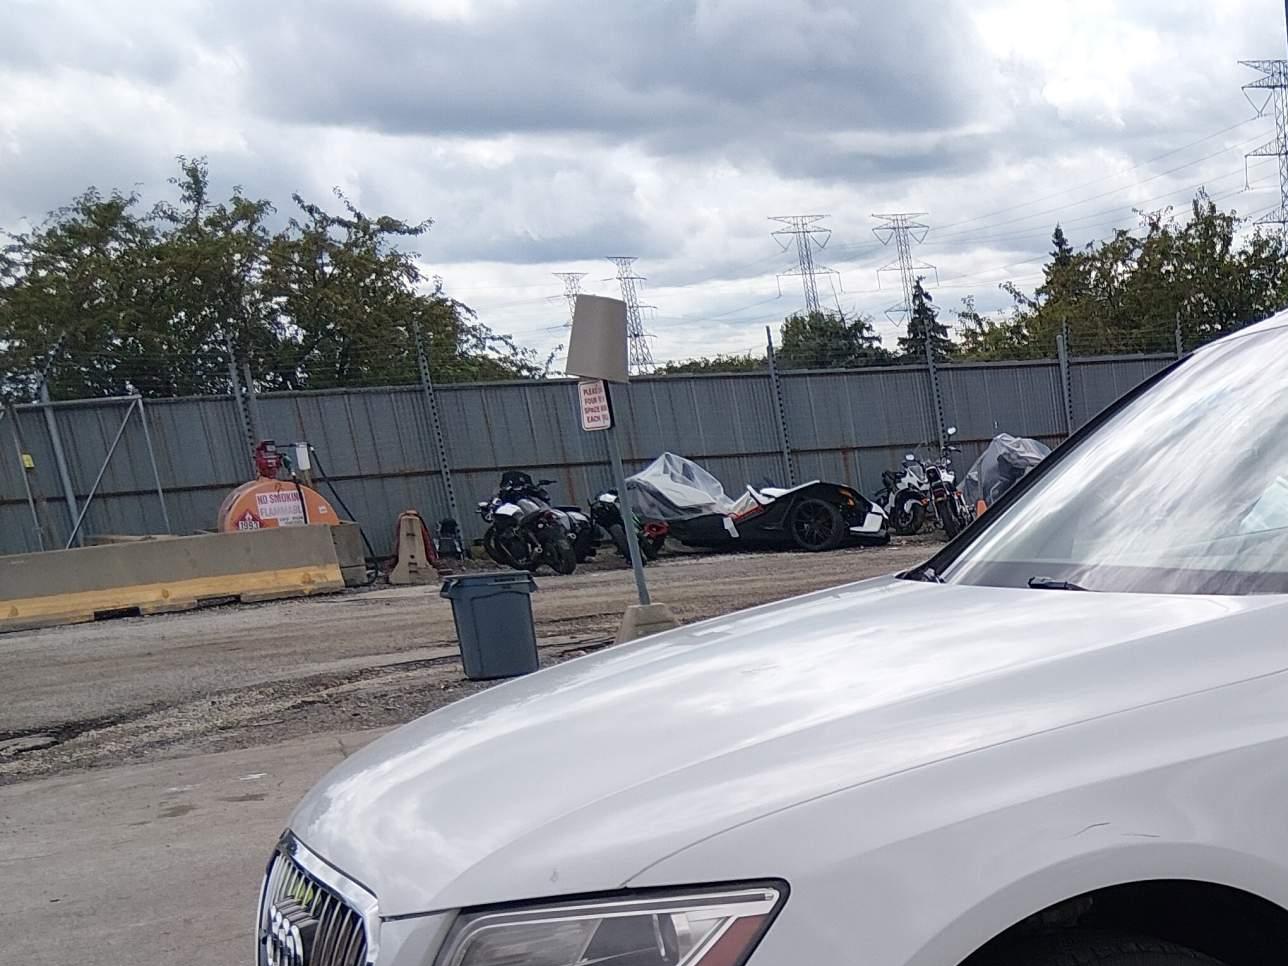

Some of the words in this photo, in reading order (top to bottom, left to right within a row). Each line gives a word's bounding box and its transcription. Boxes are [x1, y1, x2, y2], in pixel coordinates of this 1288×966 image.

[257, 495, 268, 504] NO
[270, 492, 301, 503] SMOKIN
[260, 504, 302, 517] FLAMMABL
